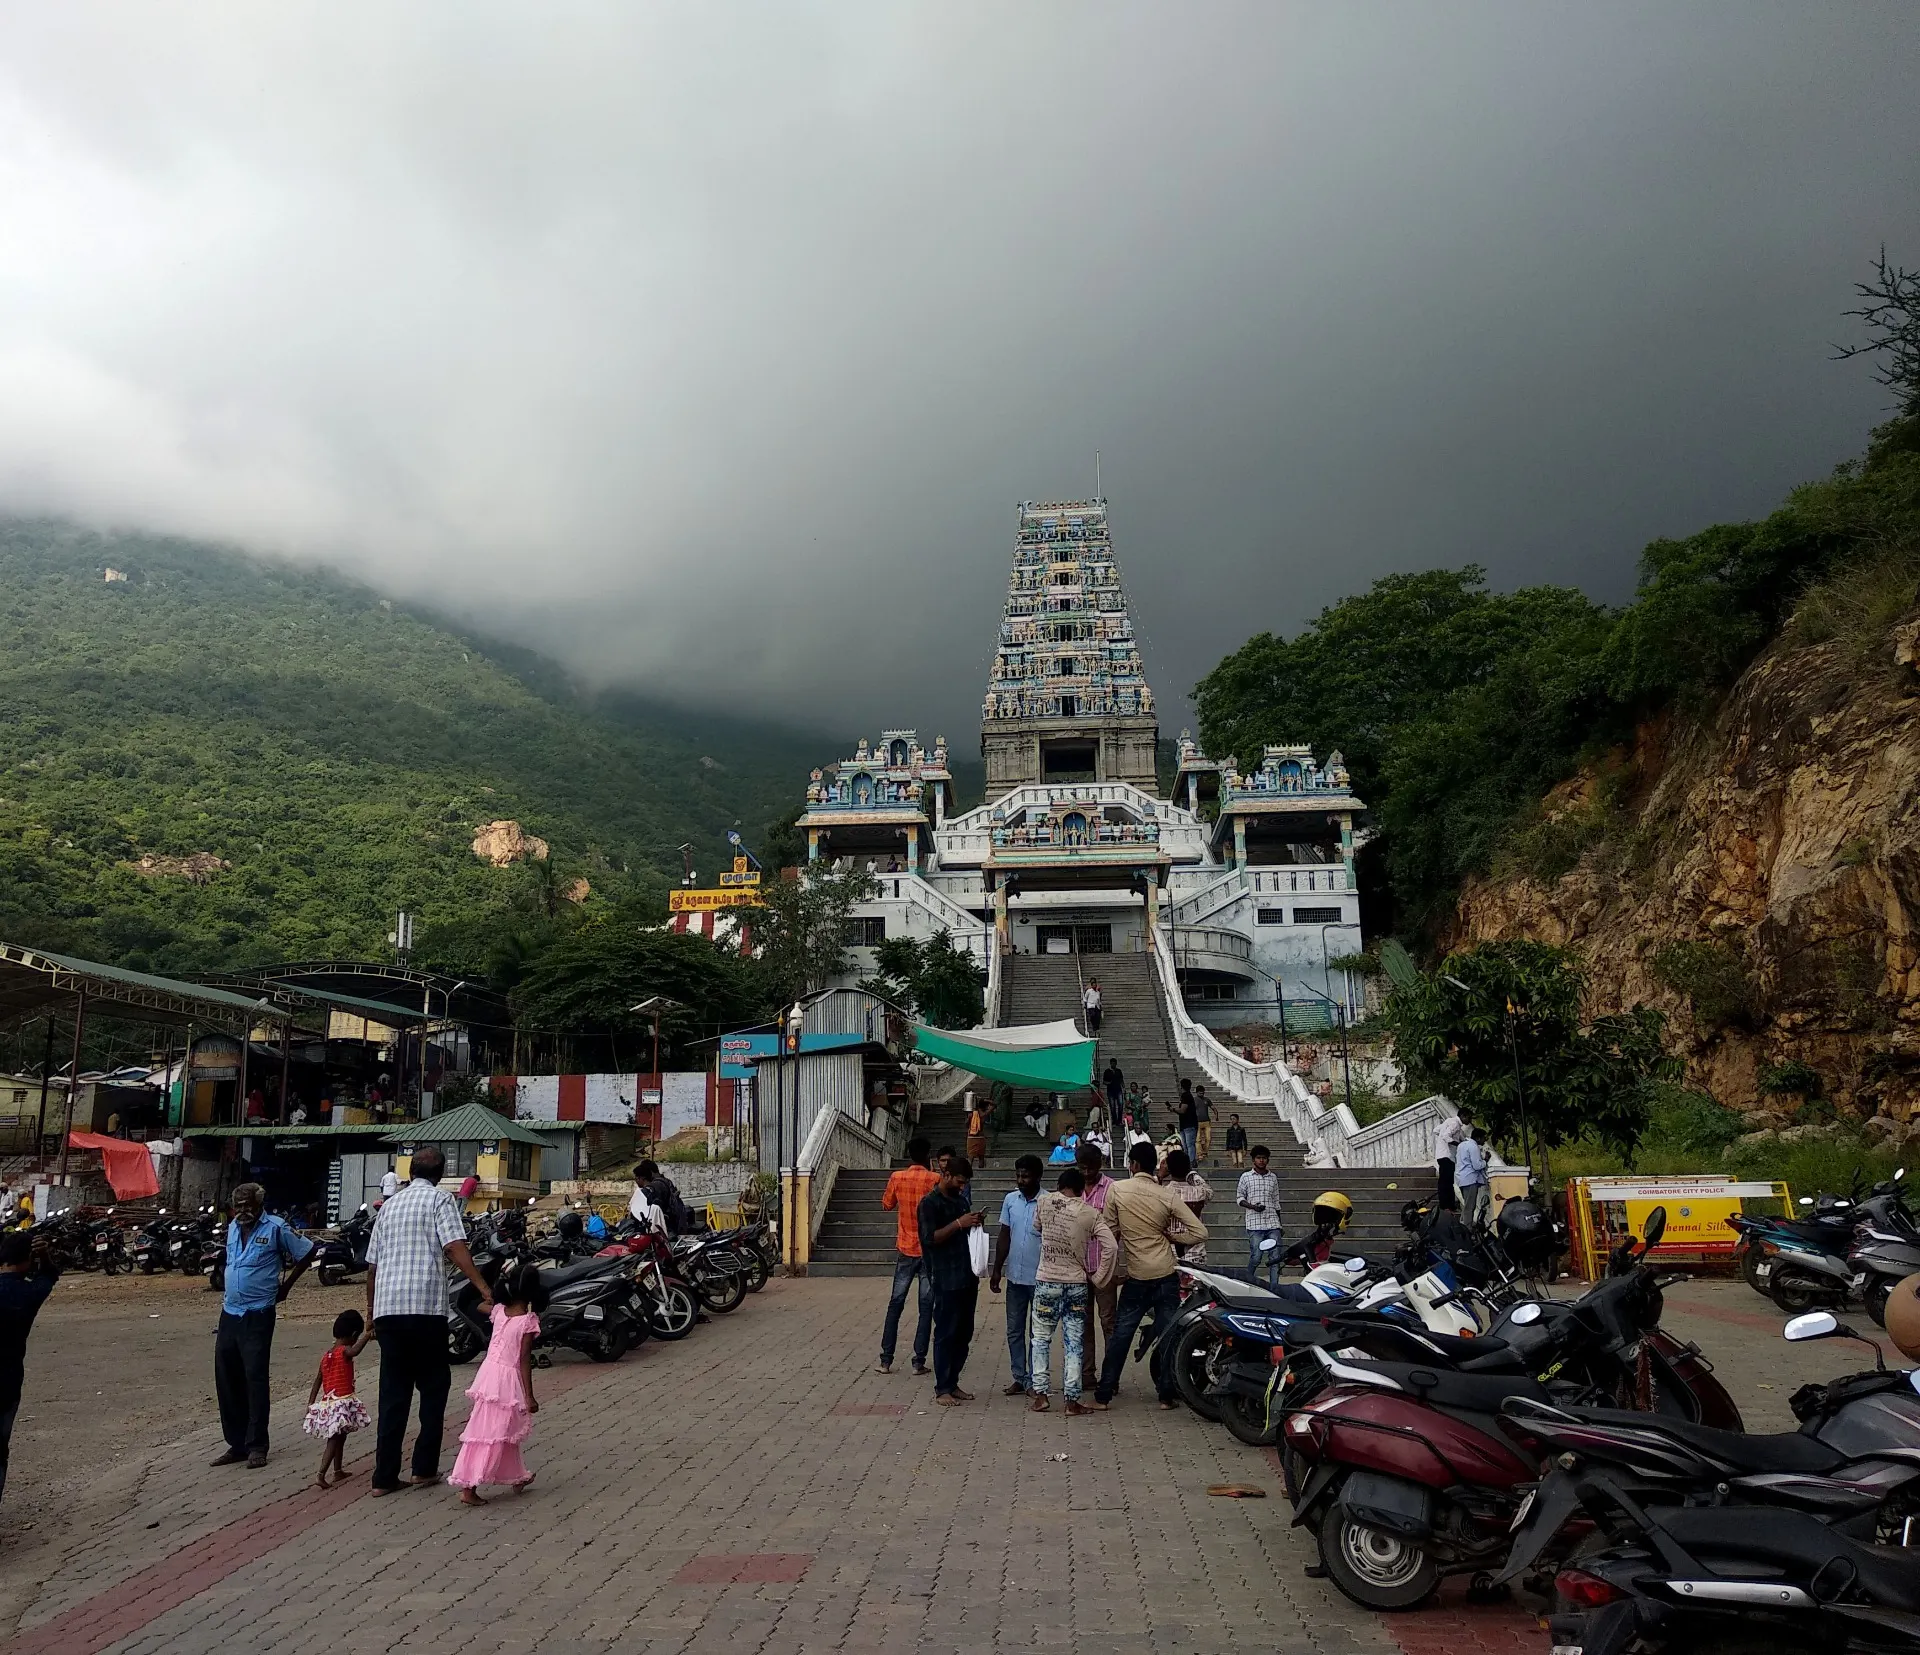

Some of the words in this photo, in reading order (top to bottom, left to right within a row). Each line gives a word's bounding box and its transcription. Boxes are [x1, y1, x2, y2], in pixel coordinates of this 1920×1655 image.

[722, 873, 758, 883] முருகா
[1665, 1222, 1701, 1232] hennai
[1706, 1221, 1731, 1231] Silks
